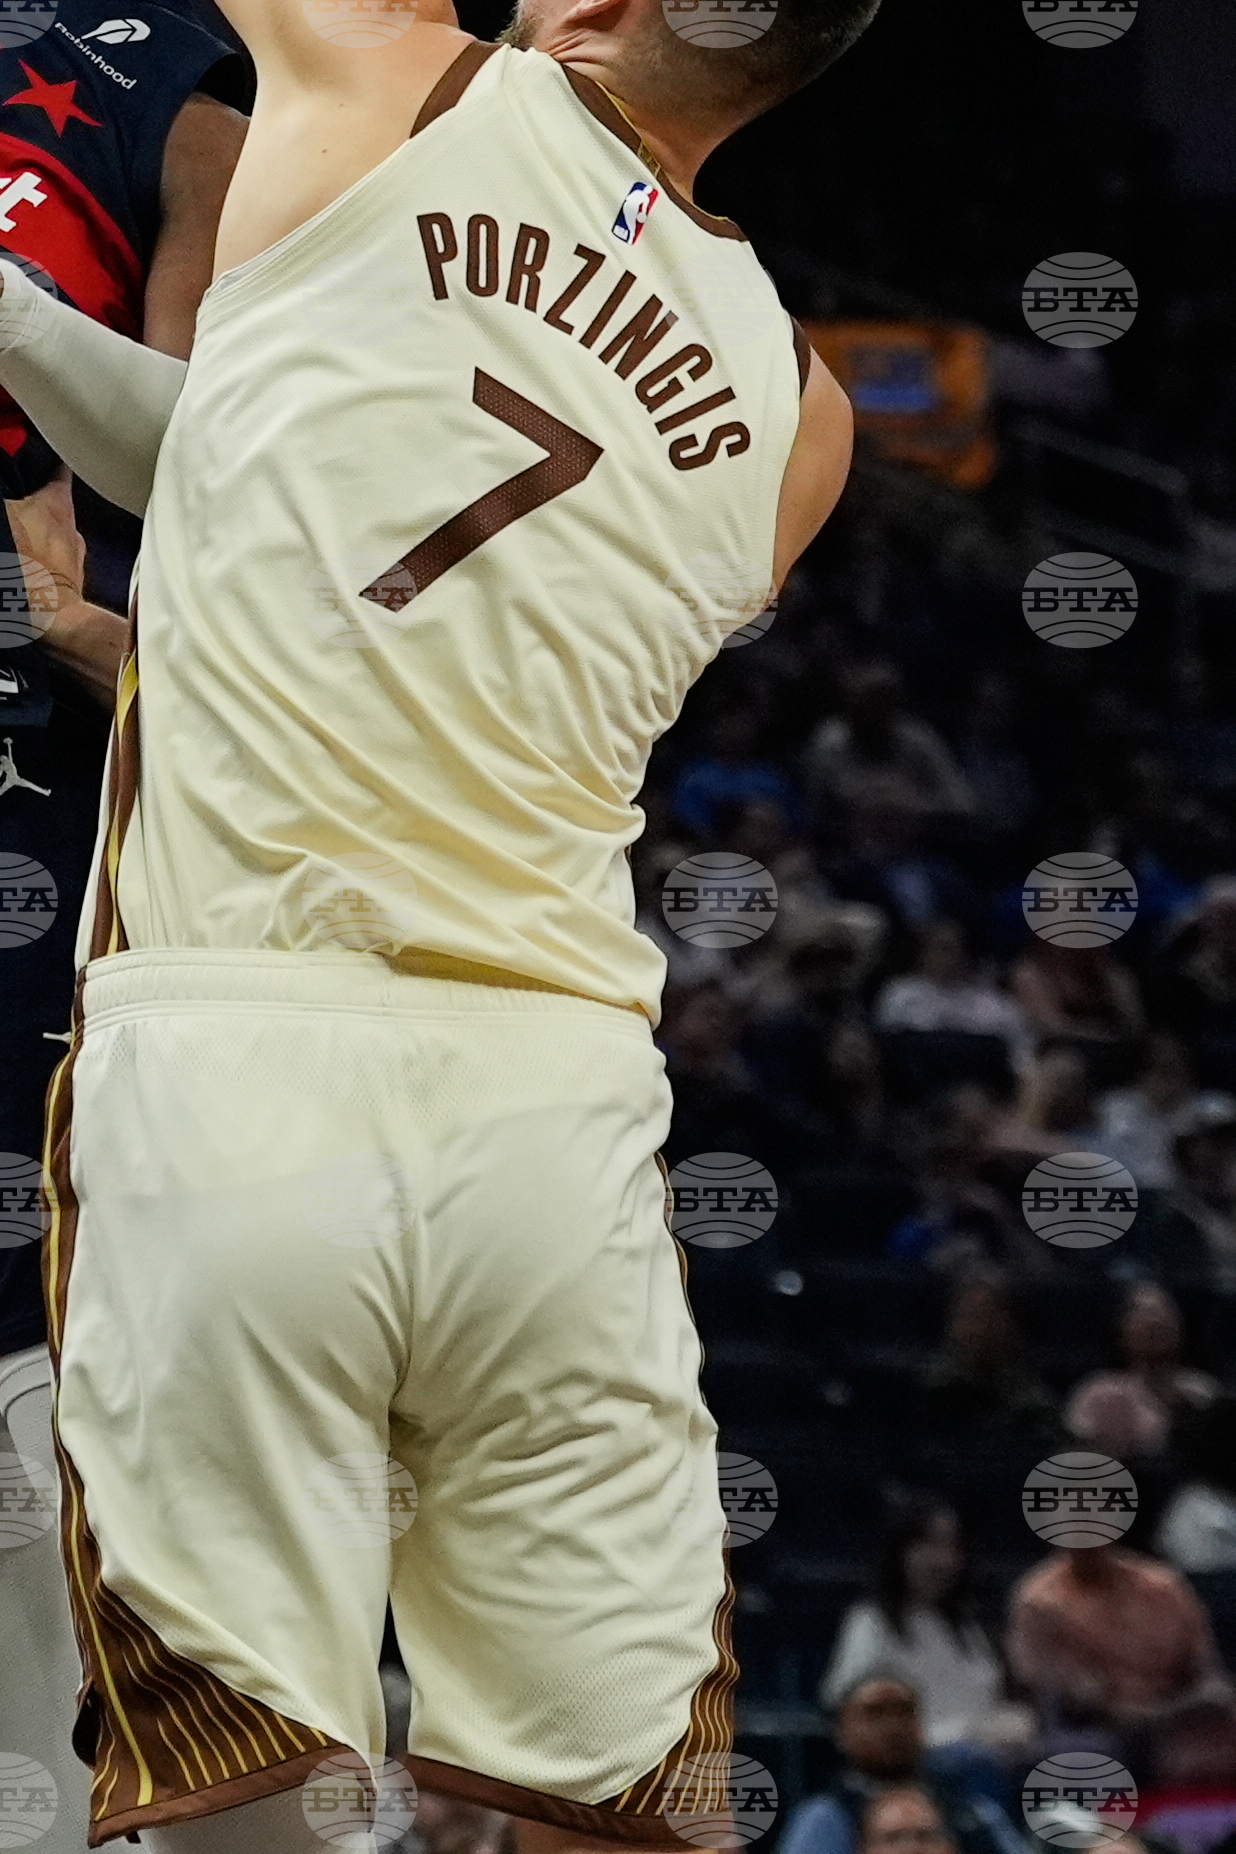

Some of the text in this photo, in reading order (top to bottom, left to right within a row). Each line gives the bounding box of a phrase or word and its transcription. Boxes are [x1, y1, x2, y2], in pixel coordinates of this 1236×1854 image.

[54, 22, 138, 90] Robinhood
[416, 211, 752, 472] PORZINGIS
[357, 365, 606, 614] 7
